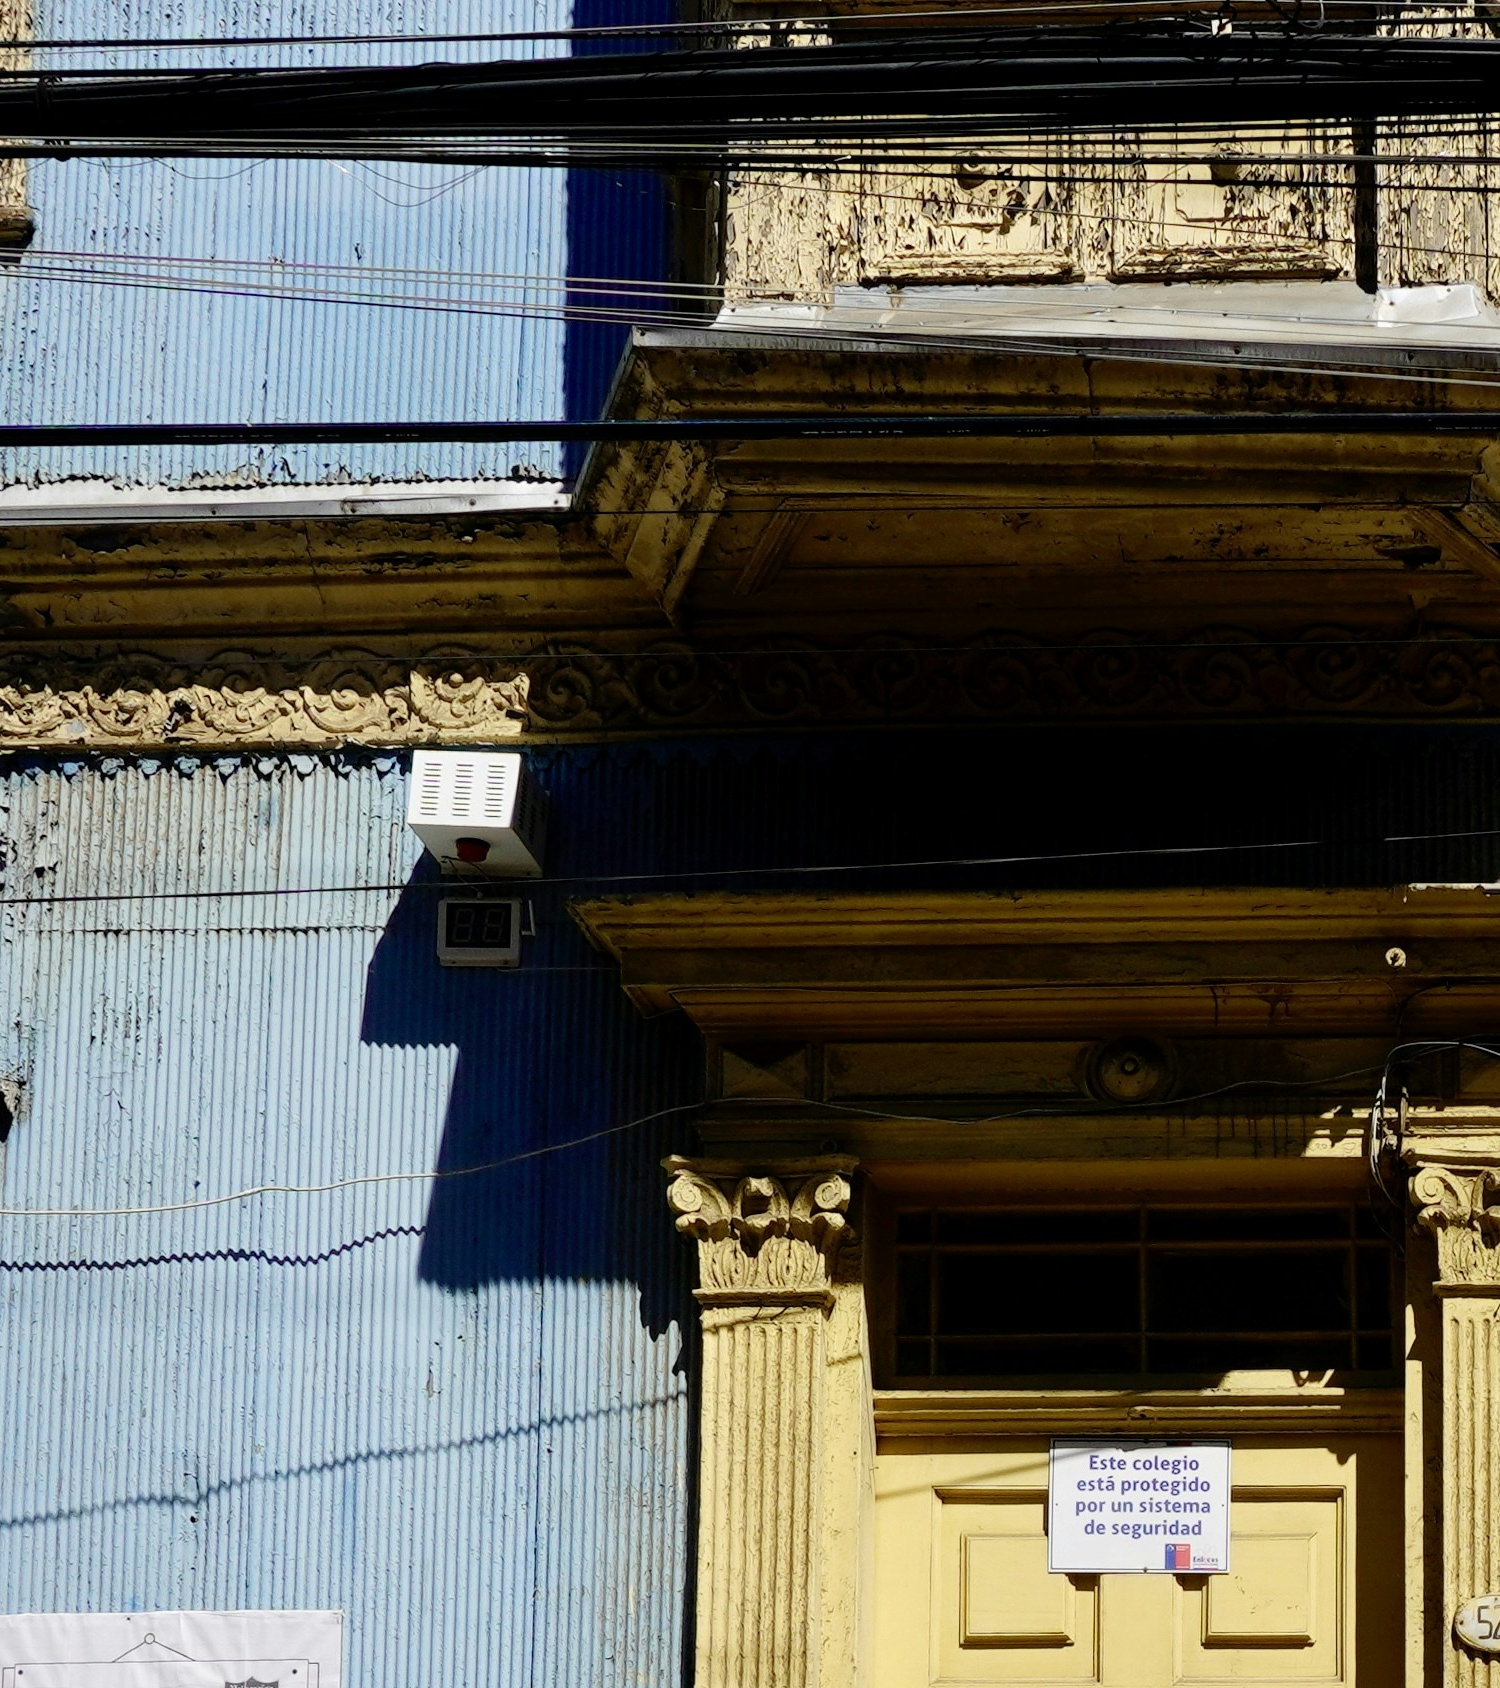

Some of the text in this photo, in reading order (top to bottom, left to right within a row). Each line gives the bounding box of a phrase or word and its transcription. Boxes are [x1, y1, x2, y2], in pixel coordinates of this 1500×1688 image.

[1089, 1455, 1200, 1475] Este colegio
[1077, 1476, 1211, 1496] está protegido
[1075, 1497, 1211, 1516] por un sistema
[1084, 1519, 1202, 1539] de seguridad
